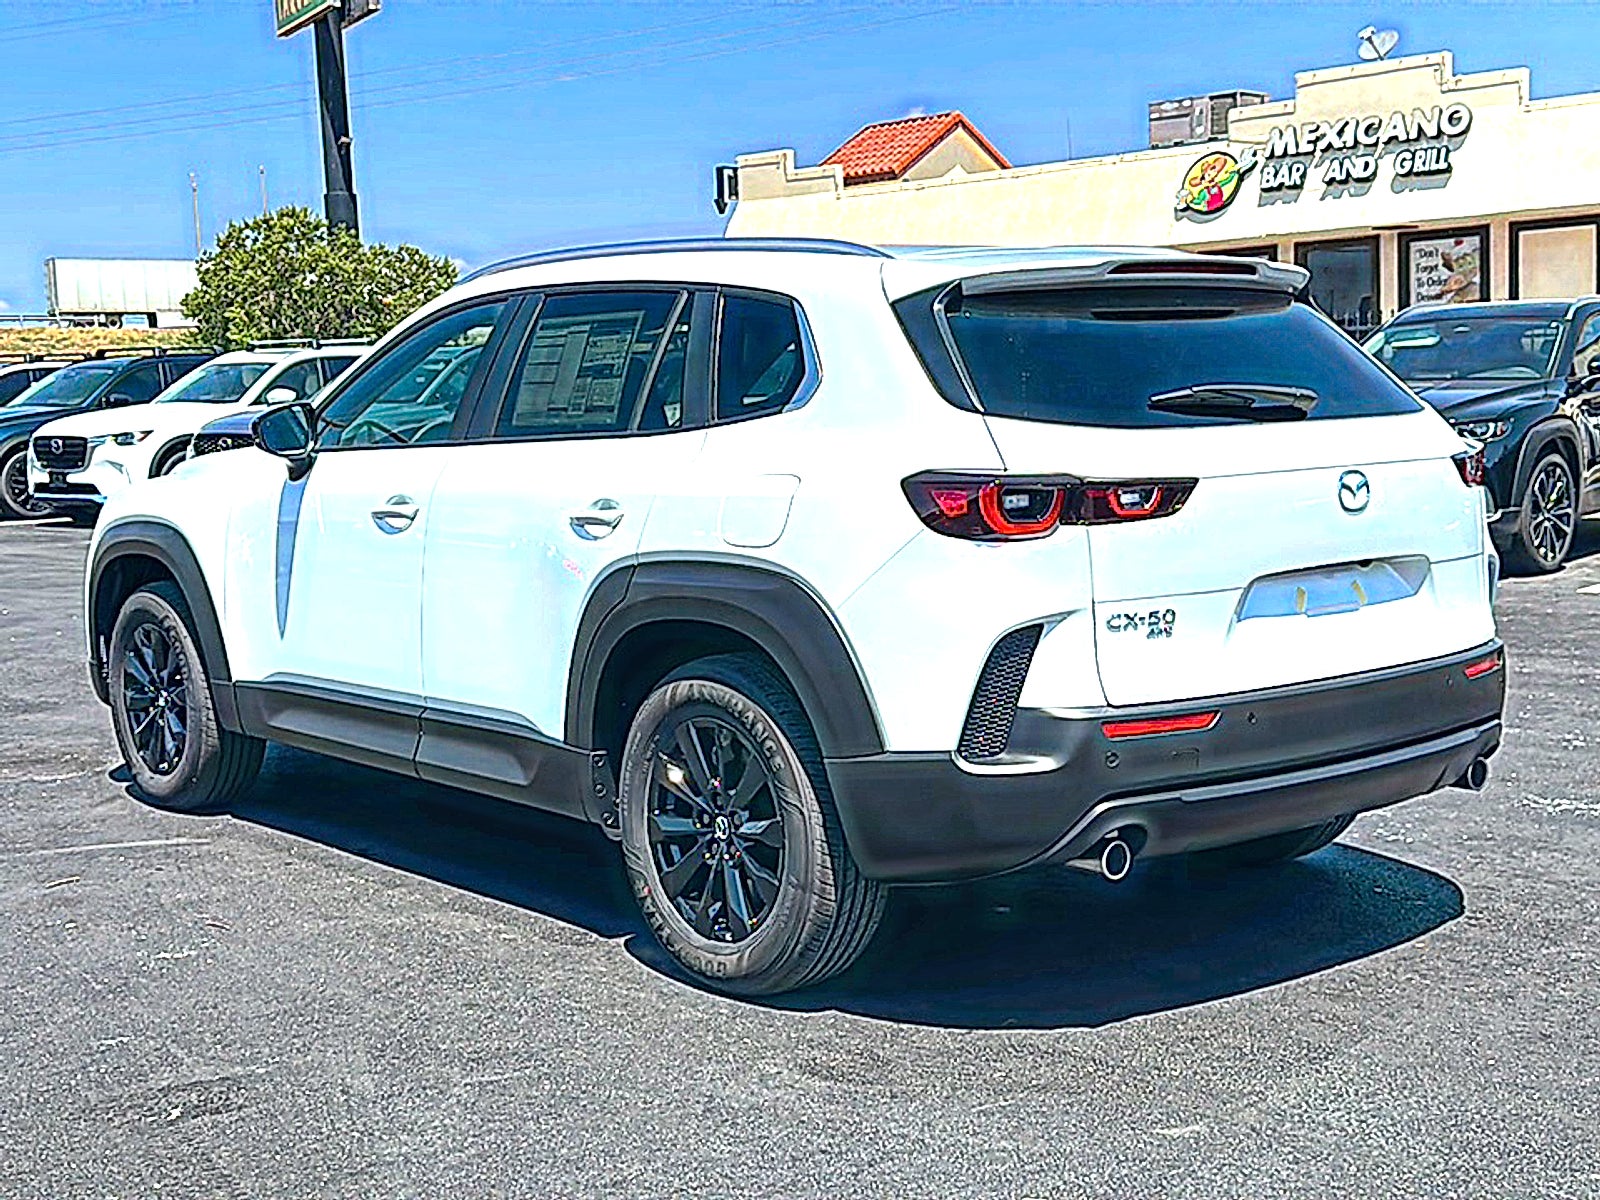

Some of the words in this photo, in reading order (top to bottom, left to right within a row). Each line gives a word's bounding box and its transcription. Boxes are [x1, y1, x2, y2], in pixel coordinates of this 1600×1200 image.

[1265, 102, 1472, 159] MEXICANO
[1260, 161, 1308, 191] BAR
[1323, 155, 1378, 185] AND
[1394, 146, 1452, 177] GRILL
[1106, 608, 1176, 633] CX-50
